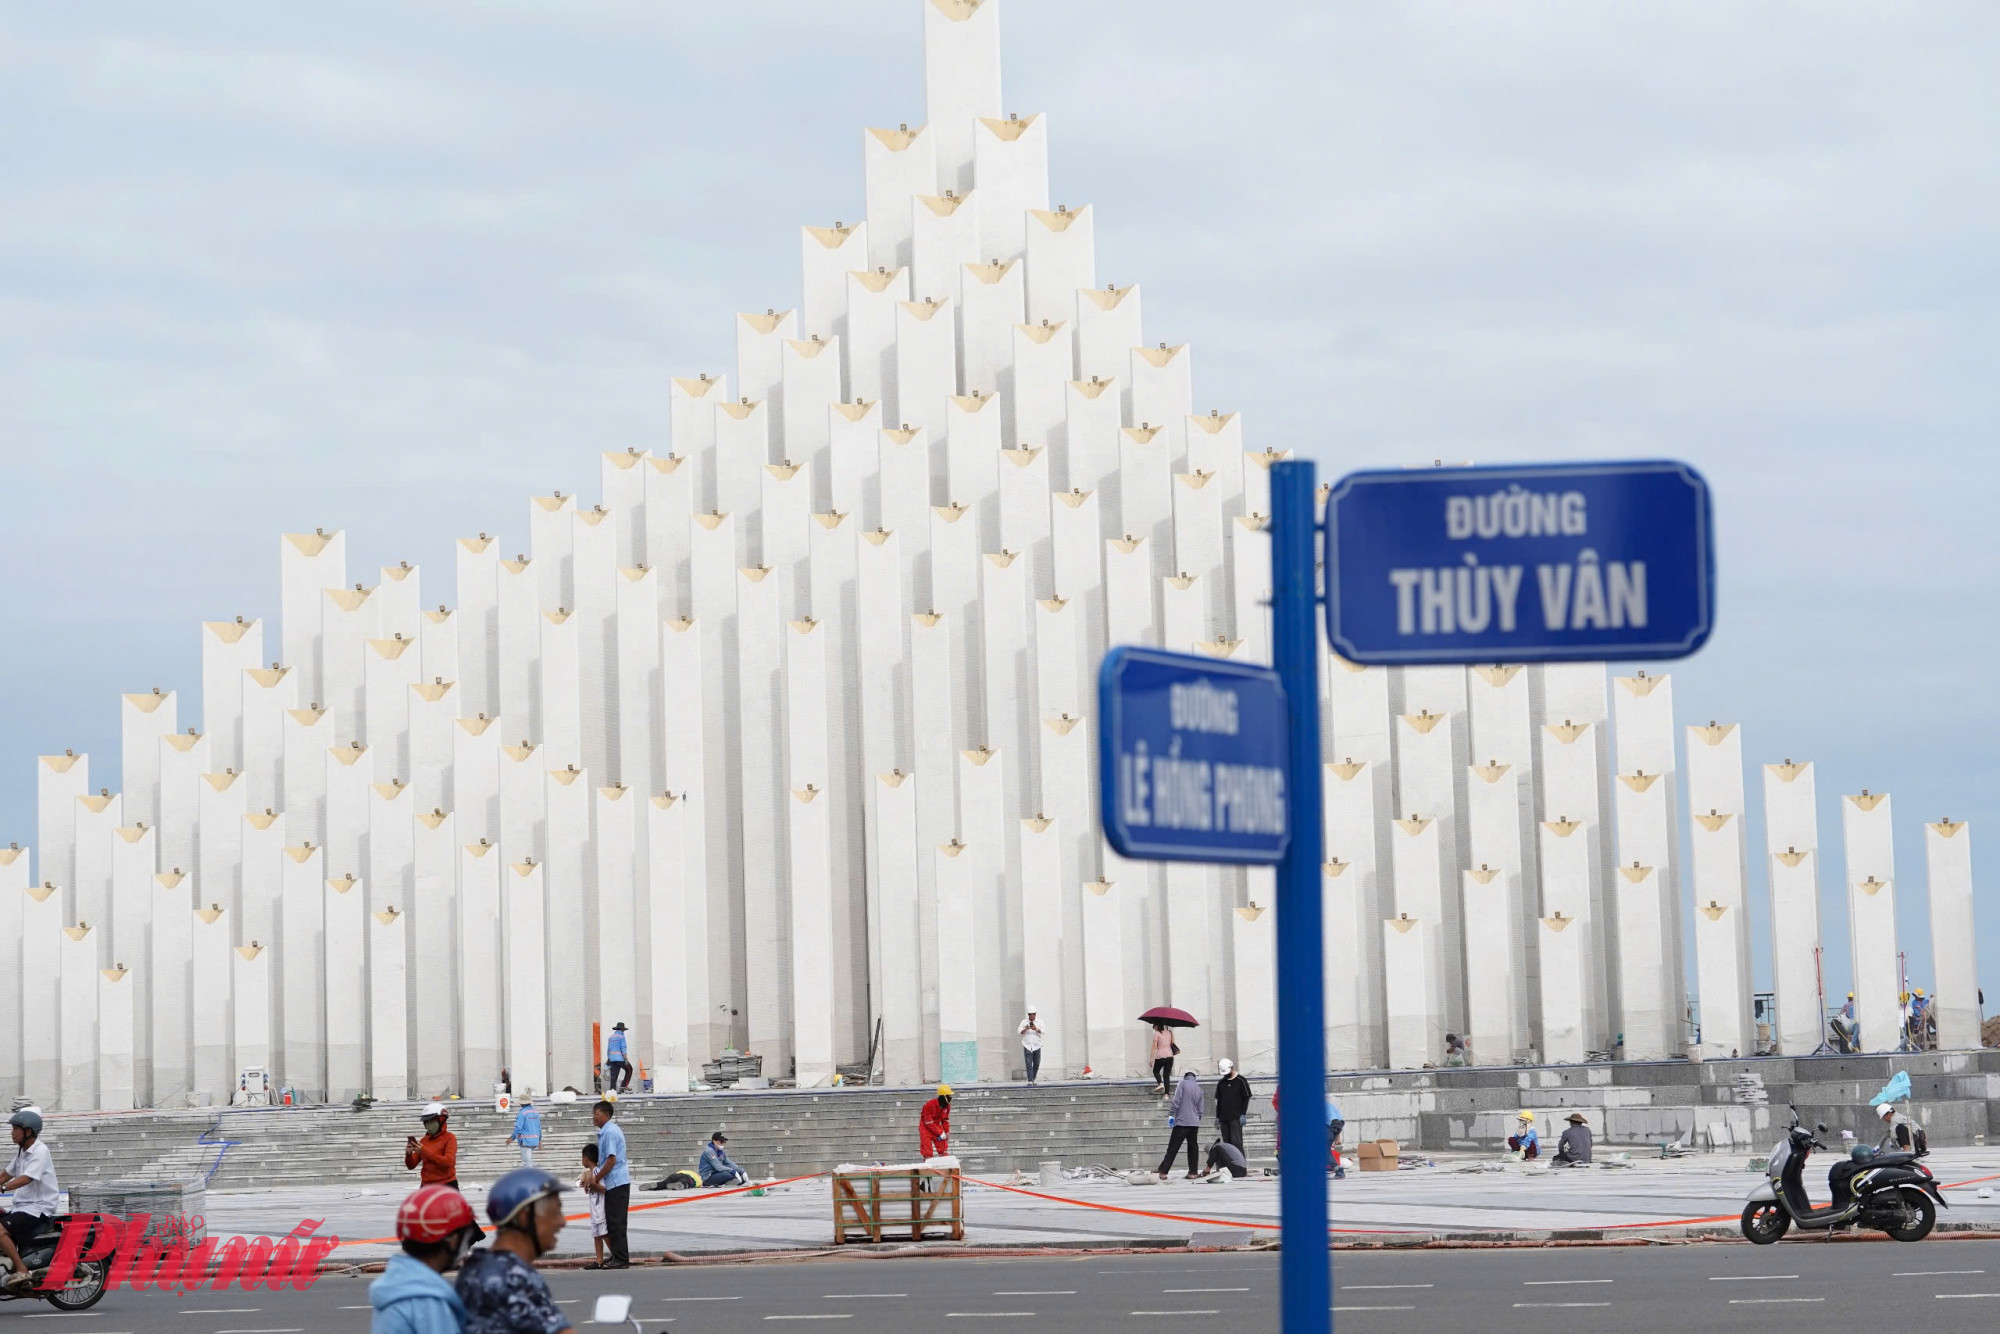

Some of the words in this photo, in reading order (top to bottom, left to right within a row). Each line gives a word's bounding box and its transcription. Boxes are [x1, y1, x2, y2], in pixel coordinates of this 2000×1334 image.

[1446, 484, 1587, 540] ĐƯỜNG
[1389, 552, 1523, 635] THÙY
[1536, 548, 1648, 631] VÂN
[1122, 739, 1149, 827] LÊ
[1214, 762, 1286, 835] PHONG
